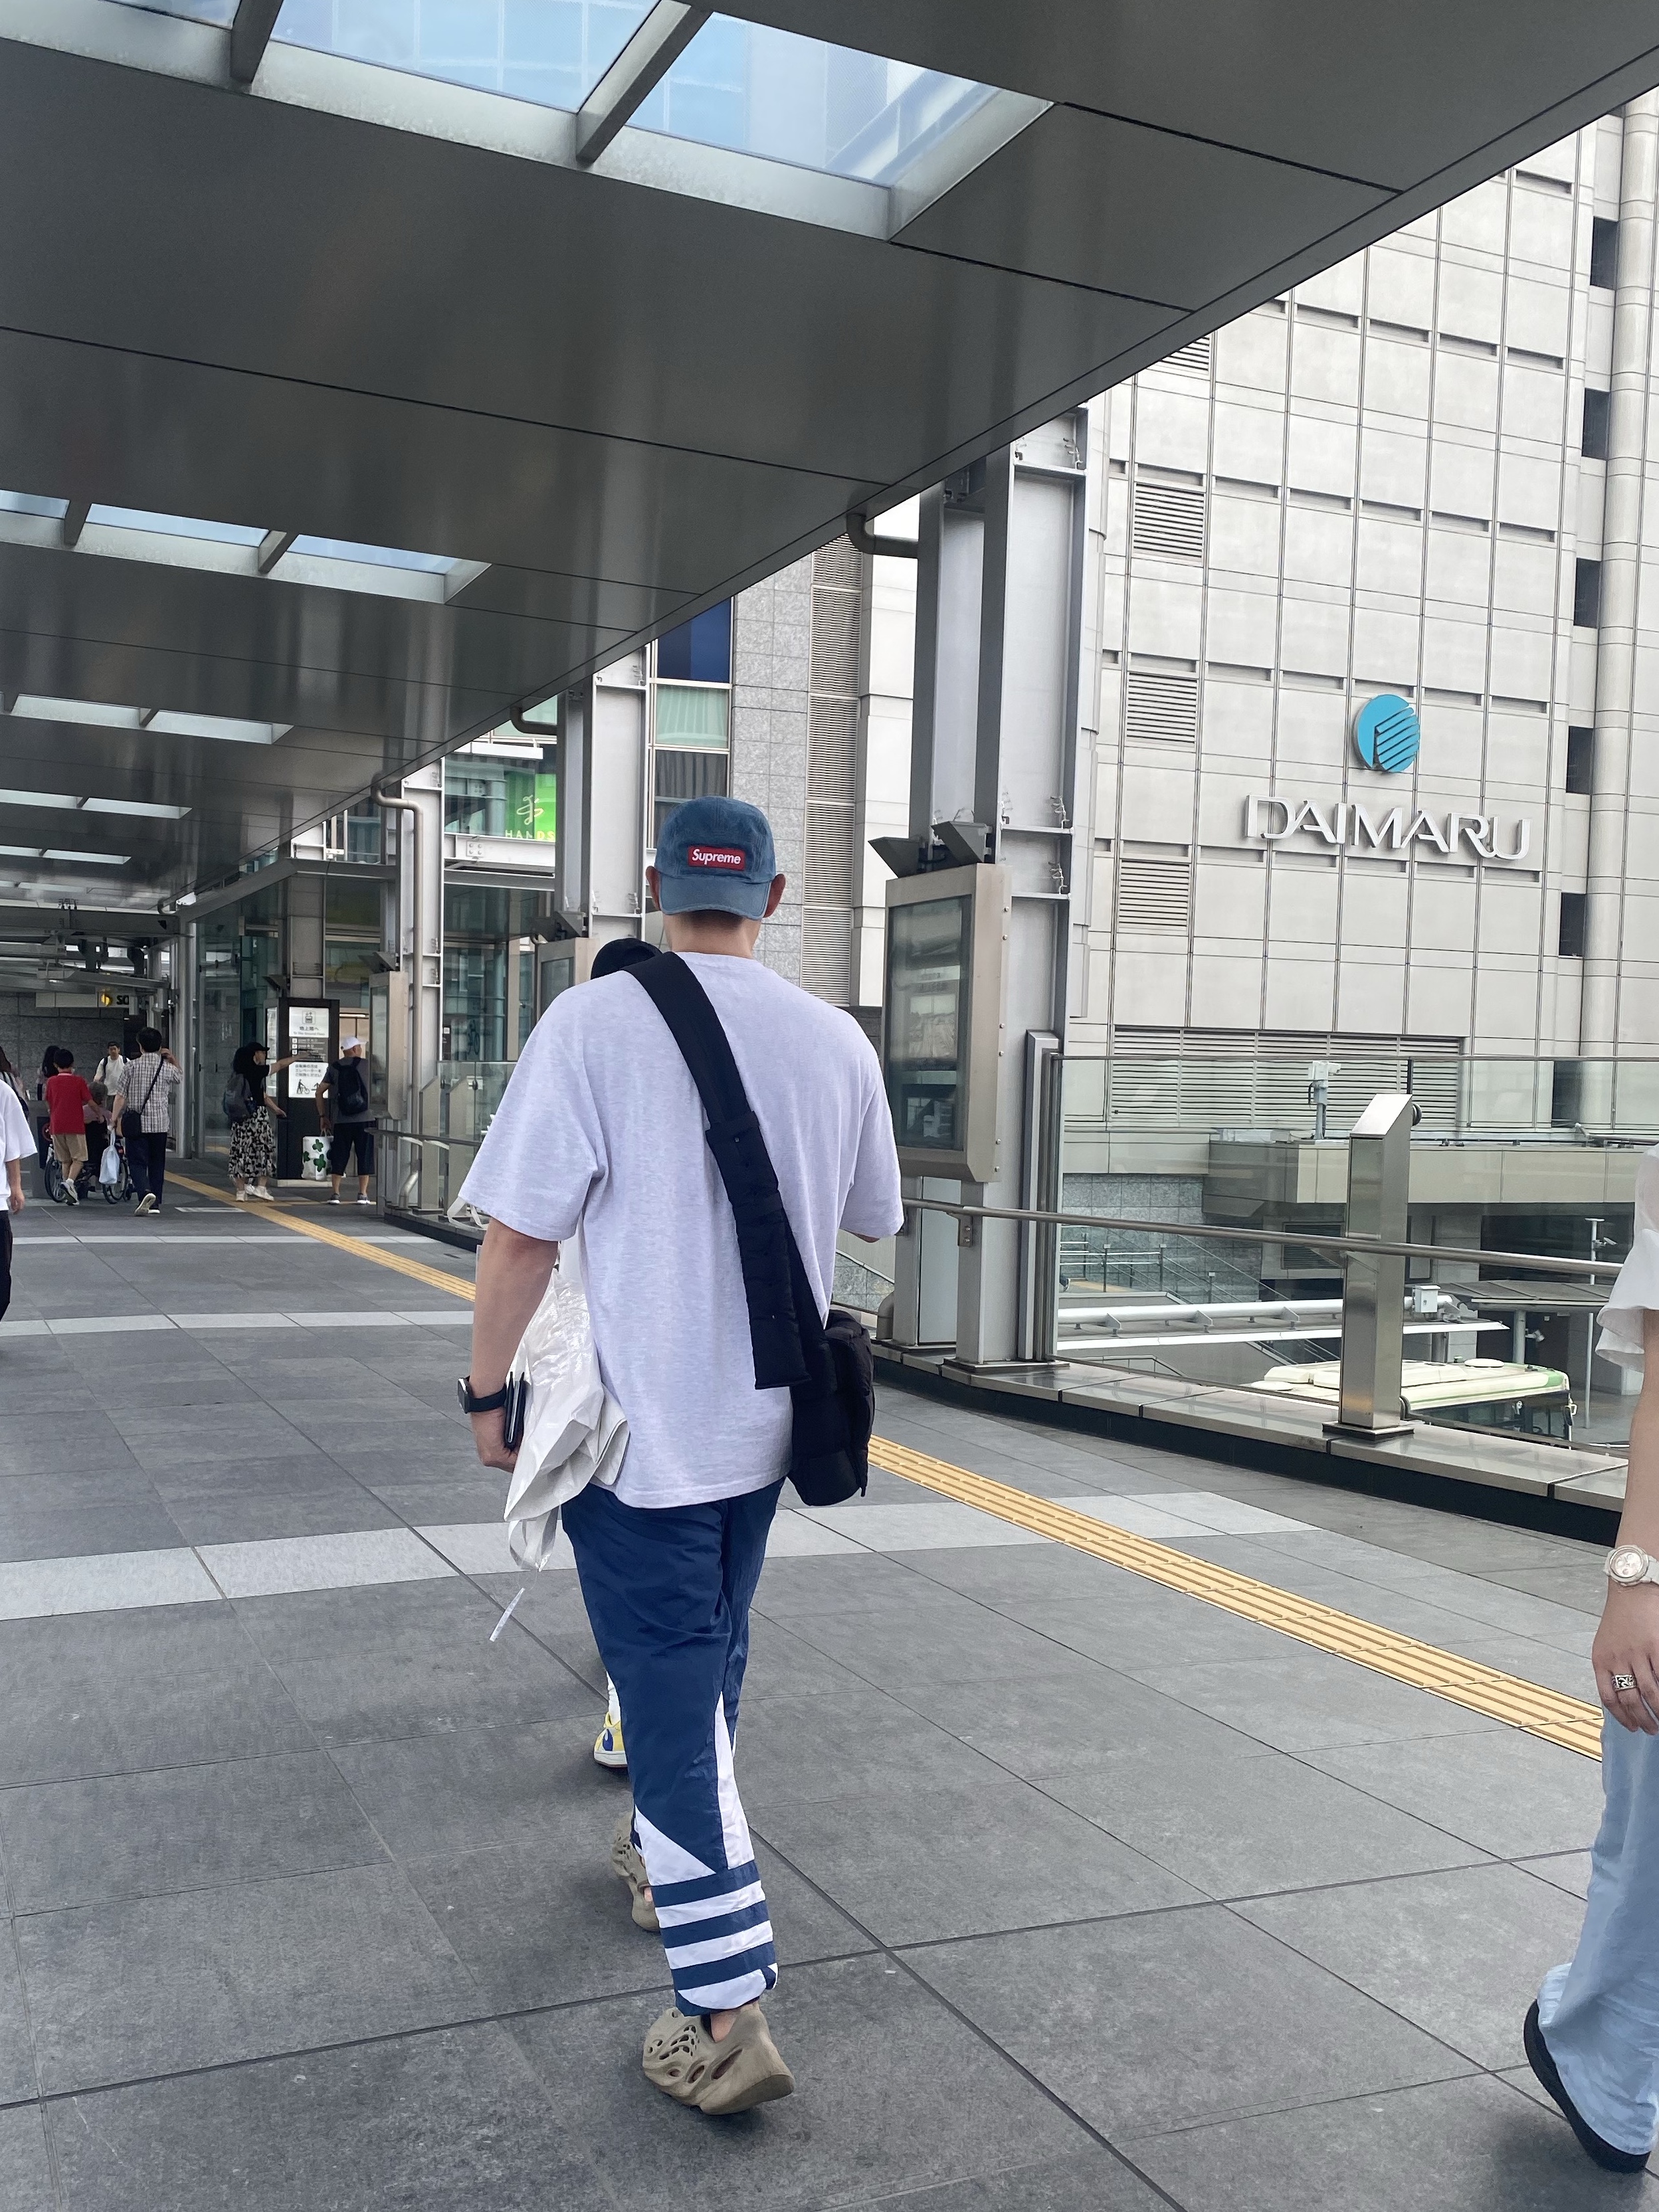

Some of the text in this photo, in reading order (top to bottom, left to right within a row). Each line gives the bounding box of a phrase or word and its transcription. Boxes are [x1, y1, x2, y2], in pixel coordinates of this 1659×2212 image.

[506, 830, 555, 840] HANDS
[1244, 794, 1532, 860] DAIMARU
[692, 848, 741, 864] Supreme
